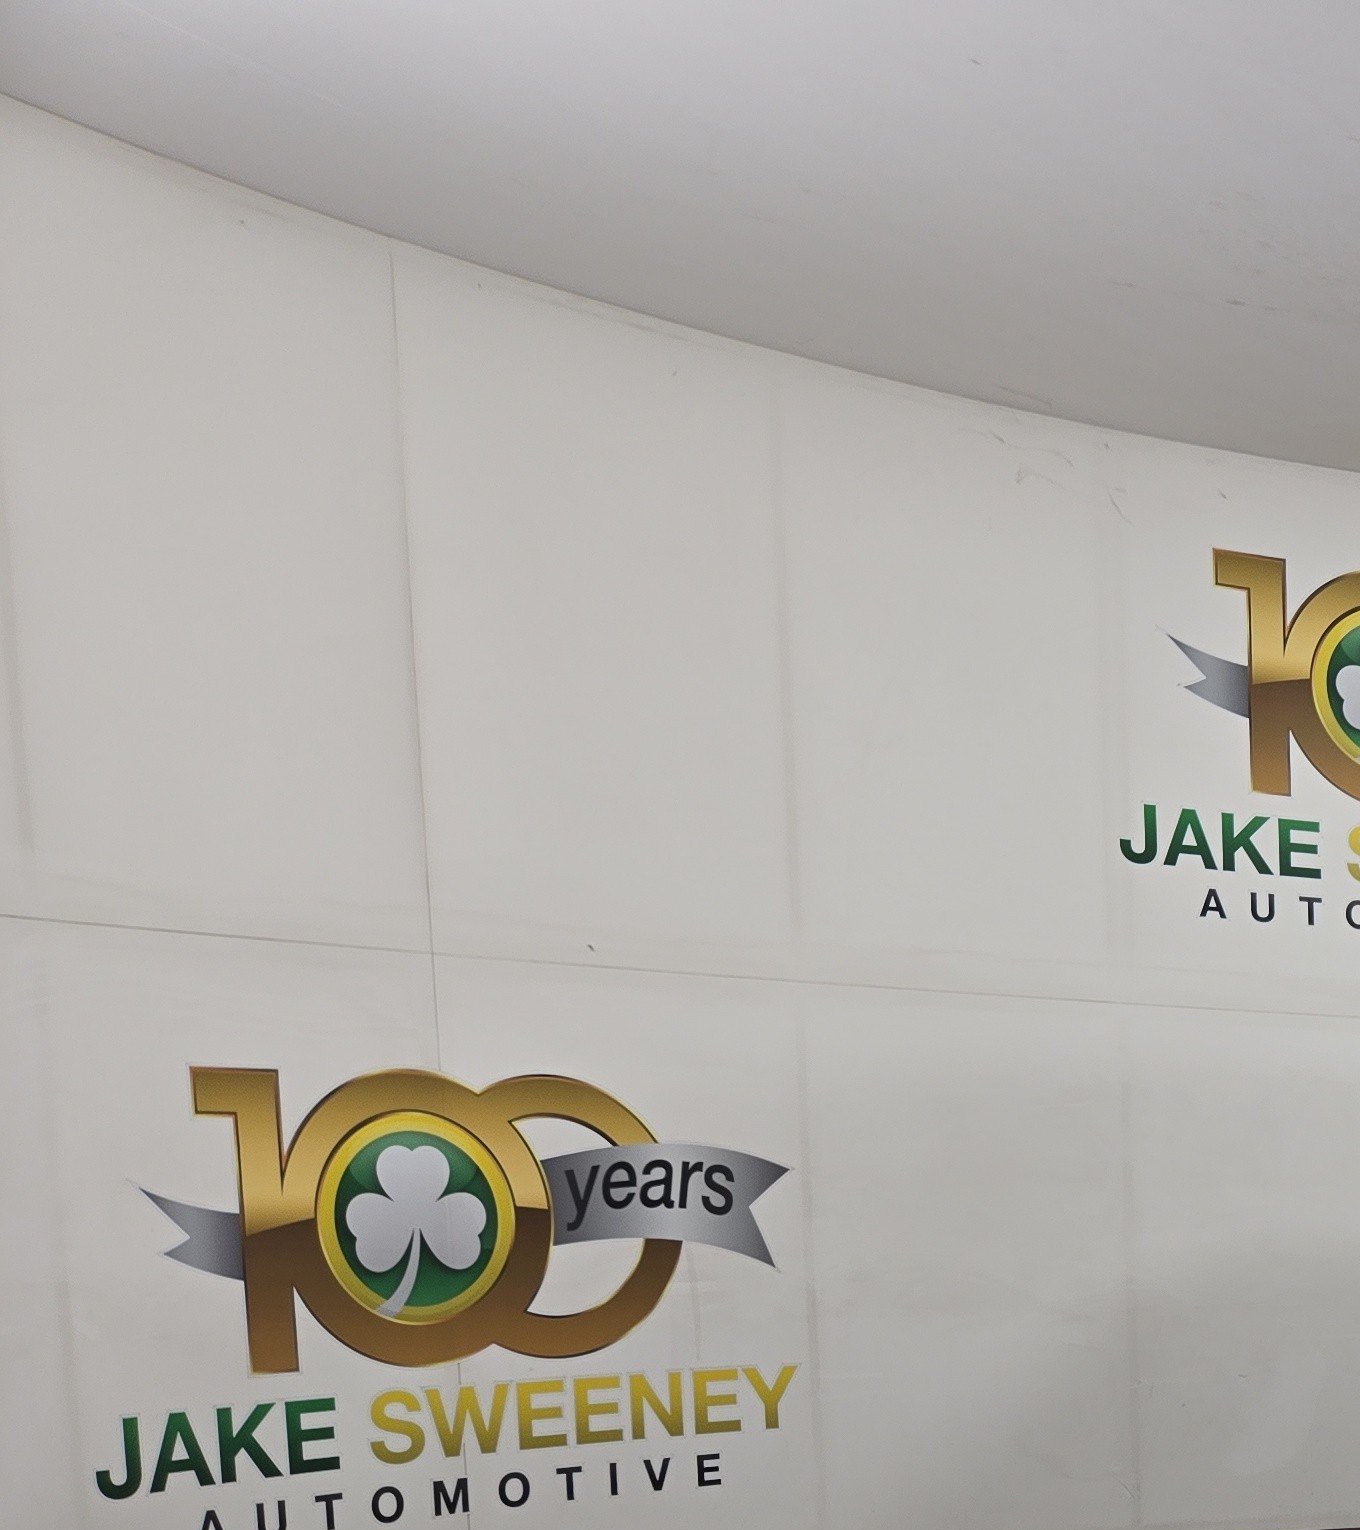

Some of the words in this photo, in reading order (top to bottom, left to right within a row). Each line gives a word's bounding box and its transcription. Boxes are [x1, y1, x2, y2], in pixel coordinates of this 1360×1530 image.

[1119, 803, 1322, 880] JAKE
[565, 1158, 736, 1230] years
[96, 1397, 341, 1500] JAKE
[369, 1364, 798, 1465] SWEENEY
